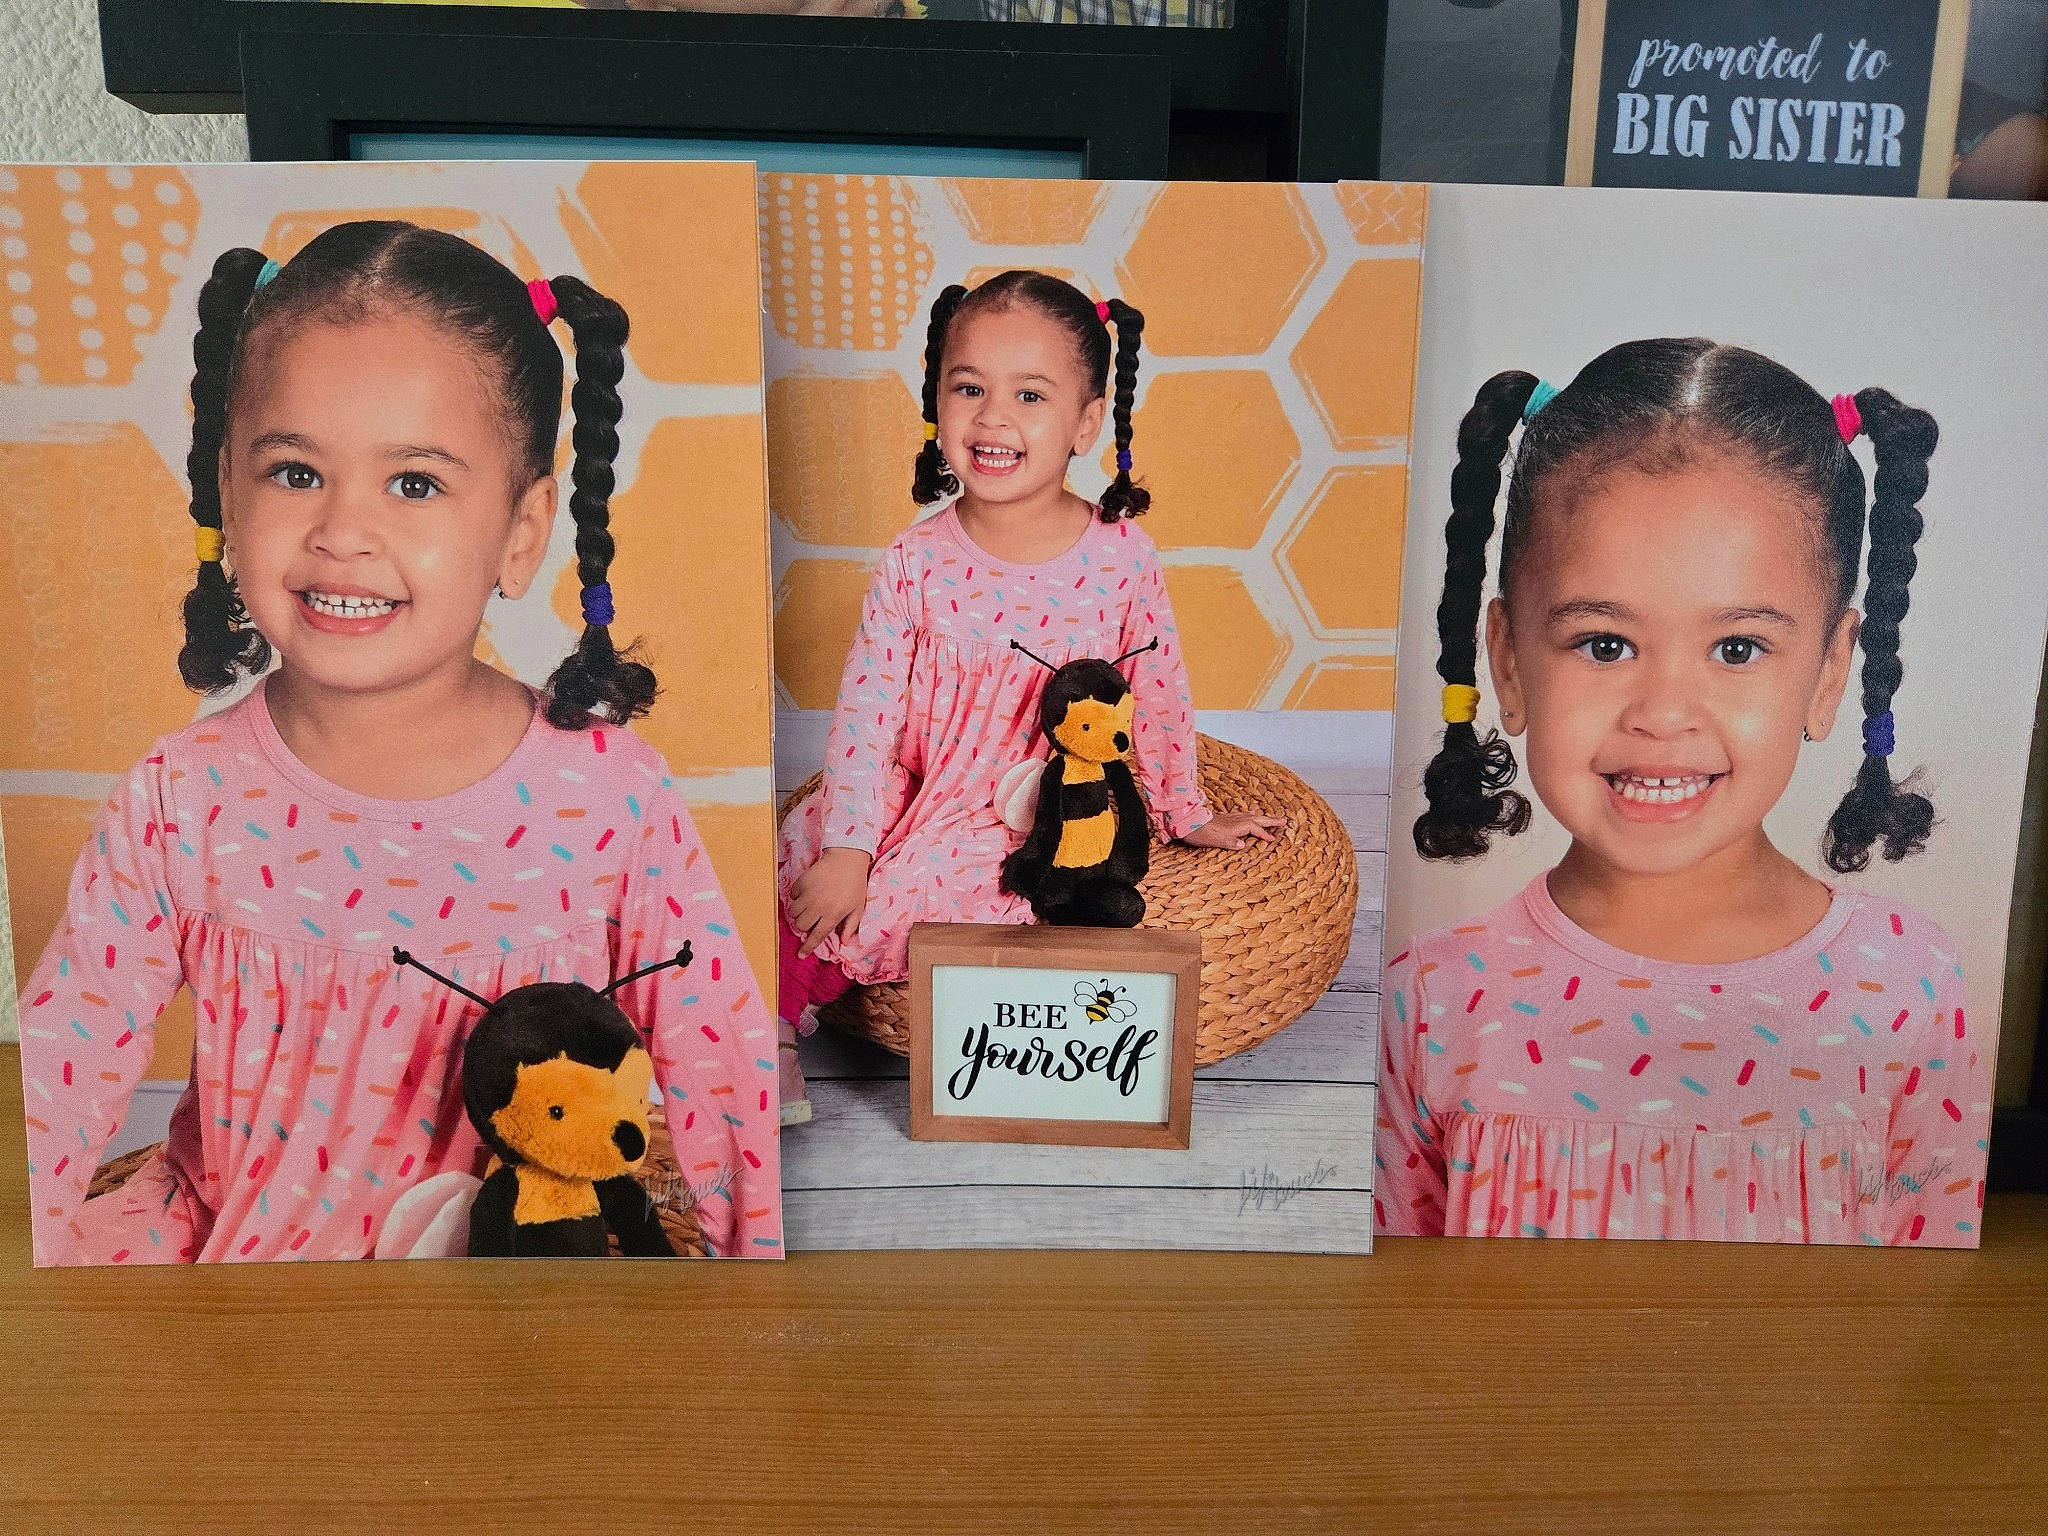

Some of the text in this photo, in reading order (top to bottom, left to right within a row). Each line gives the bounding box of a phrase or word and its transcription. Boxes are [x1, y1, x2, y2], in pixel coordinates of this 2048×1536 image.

[1629, 33, 1892, 89] promoted to
[1612, 92, 1906, 167] BIG SISTER
[993, 1002, 1067, 1030] BEE
[948, 1023, 1158, 1100] yourself
